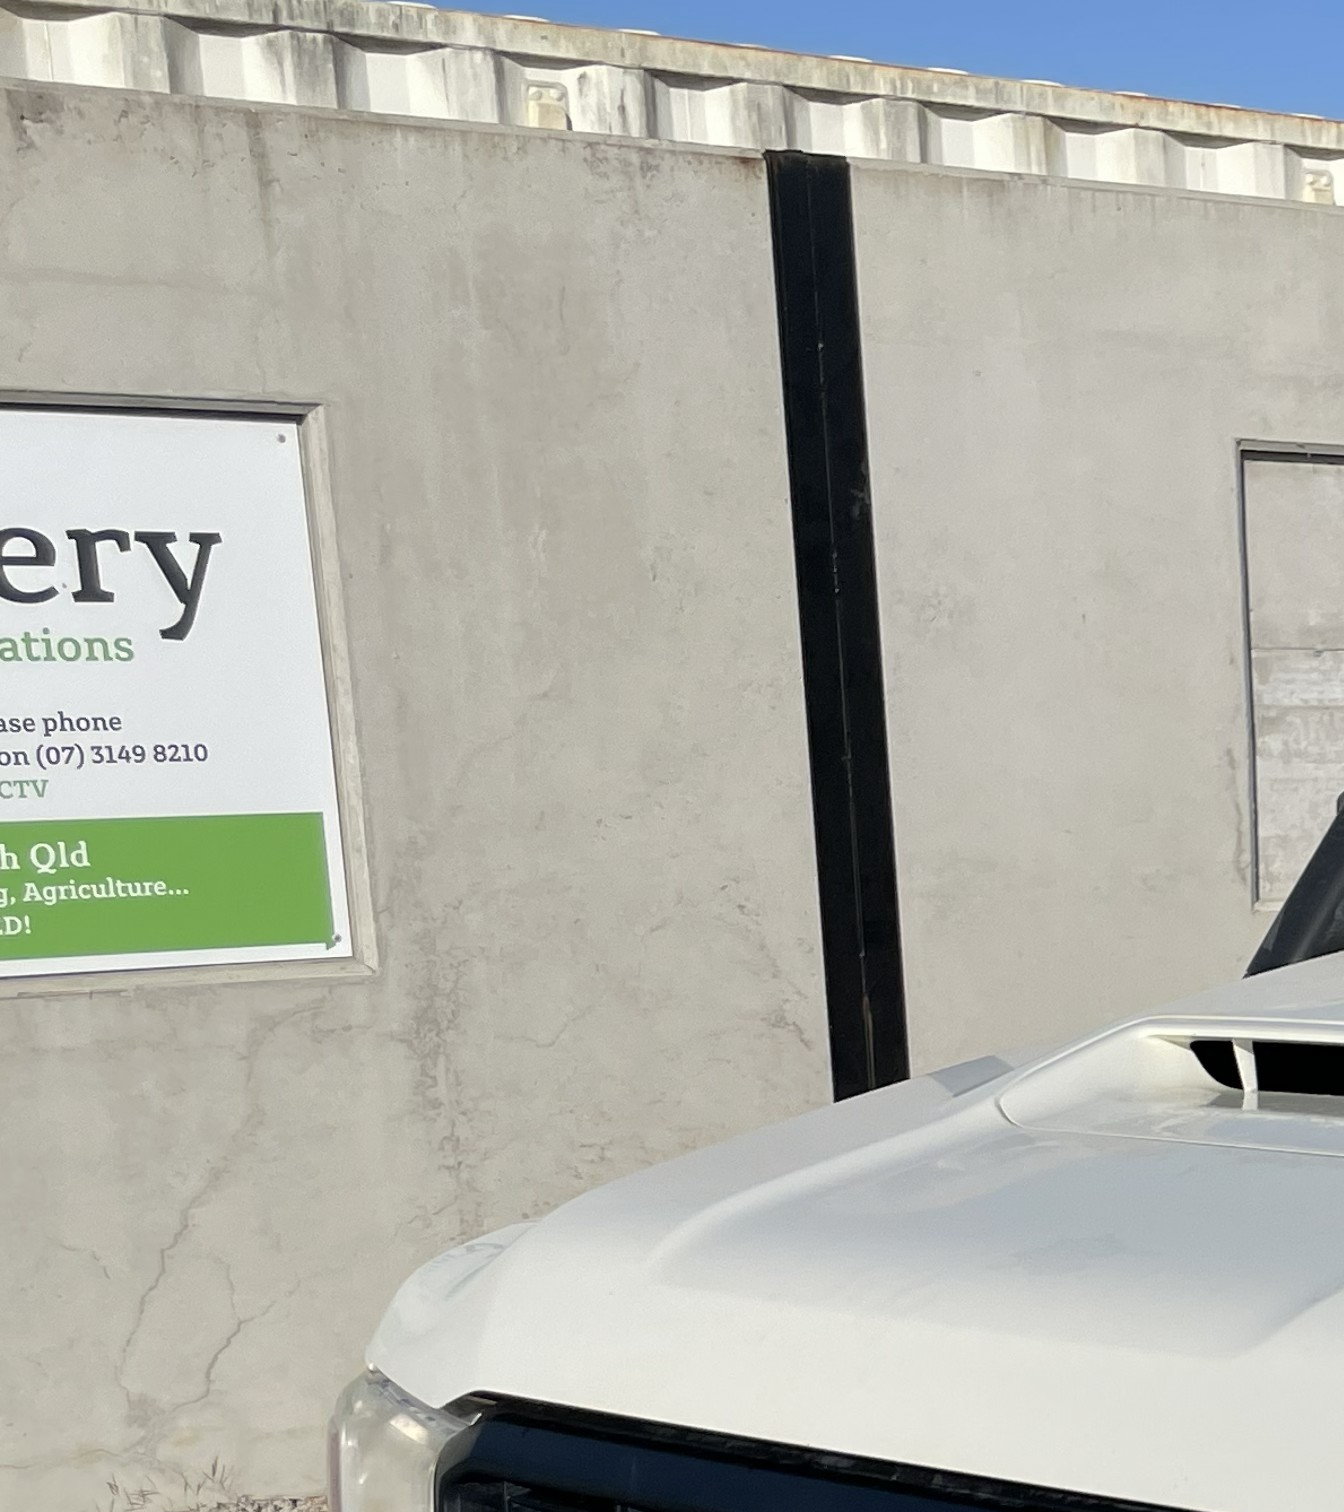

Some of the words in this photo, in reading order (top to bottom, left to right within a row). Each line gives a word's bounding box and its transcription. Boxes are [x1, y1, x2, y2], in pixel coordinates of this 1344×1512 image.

[0, 527, 223, 641] ery
[0, 627, 135, 662] ations
[42, 711, 122, 737] phone
[36, 743, 84, 770] (07)
[91, 745, 146, 764] 3149
[153, 743, 208, 763] 8210
[0, 779, 49, 799] CTV
[29, 840, 91, 874] Qld
[22, 876, 190, 906] Agriculture...
[0, 914, 32, 936] D!
